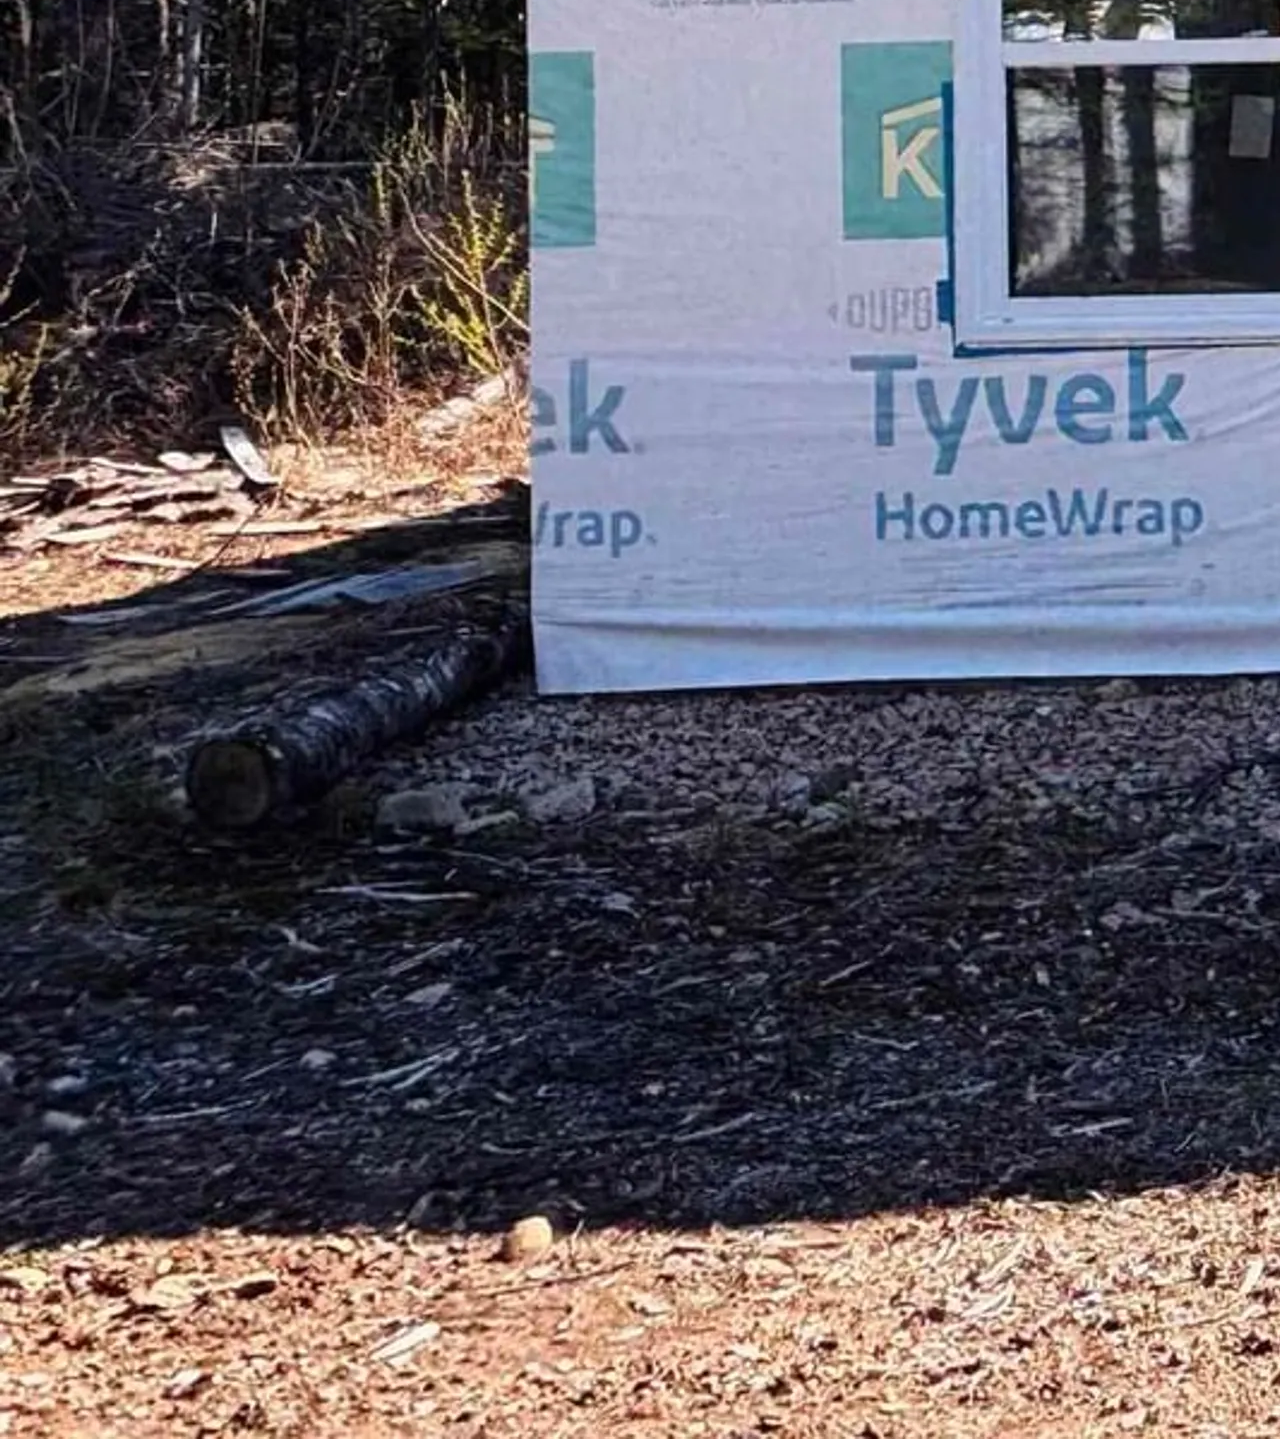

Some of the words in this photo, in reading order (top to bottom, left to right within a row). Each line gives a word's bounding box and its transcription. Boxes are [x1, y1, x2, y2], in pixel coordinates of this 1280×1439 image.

[846, 286, 942, 332] DUPO
[849, 346, 1190, 476] Tyvek
[874, 487, 1204, 546] HomeWrap
